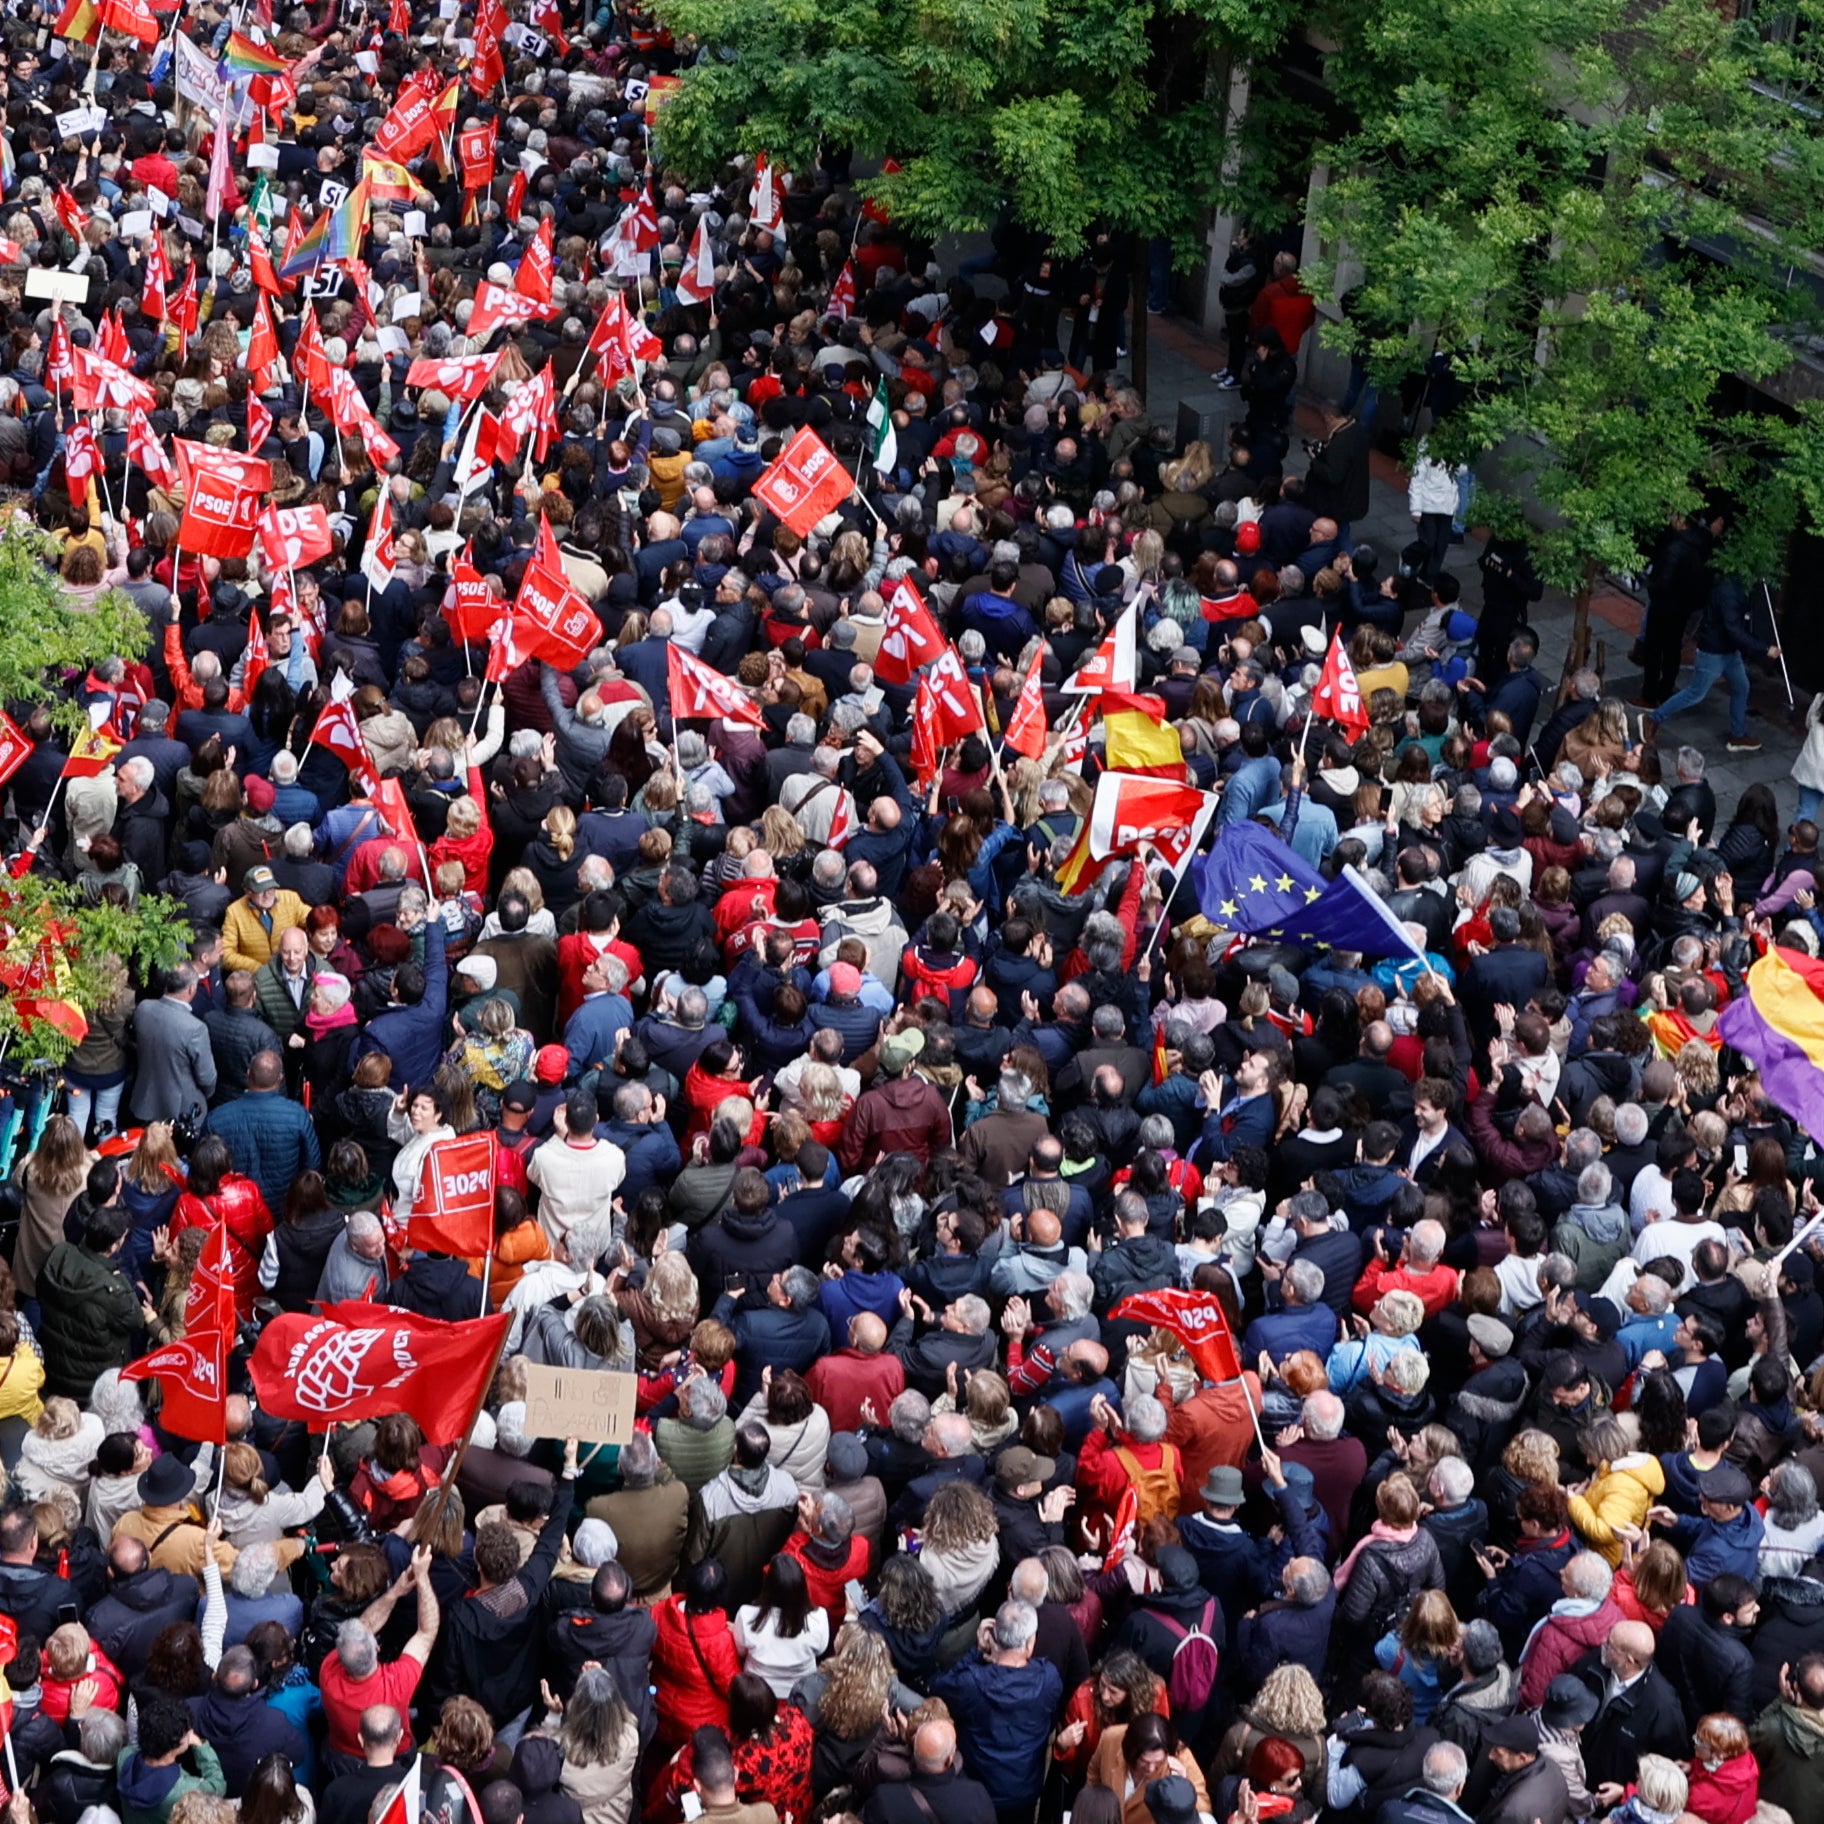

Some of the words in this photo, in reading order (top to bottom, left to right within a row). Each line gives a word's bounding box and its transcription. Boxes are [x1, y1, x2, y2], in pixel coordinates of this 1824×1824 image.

[522, 35, 542, 52] Sí
[324, 187, 343, 206] Sí
[195, 492, 233, 516] PSOE
[523, 583, 556, 619] PSOE
